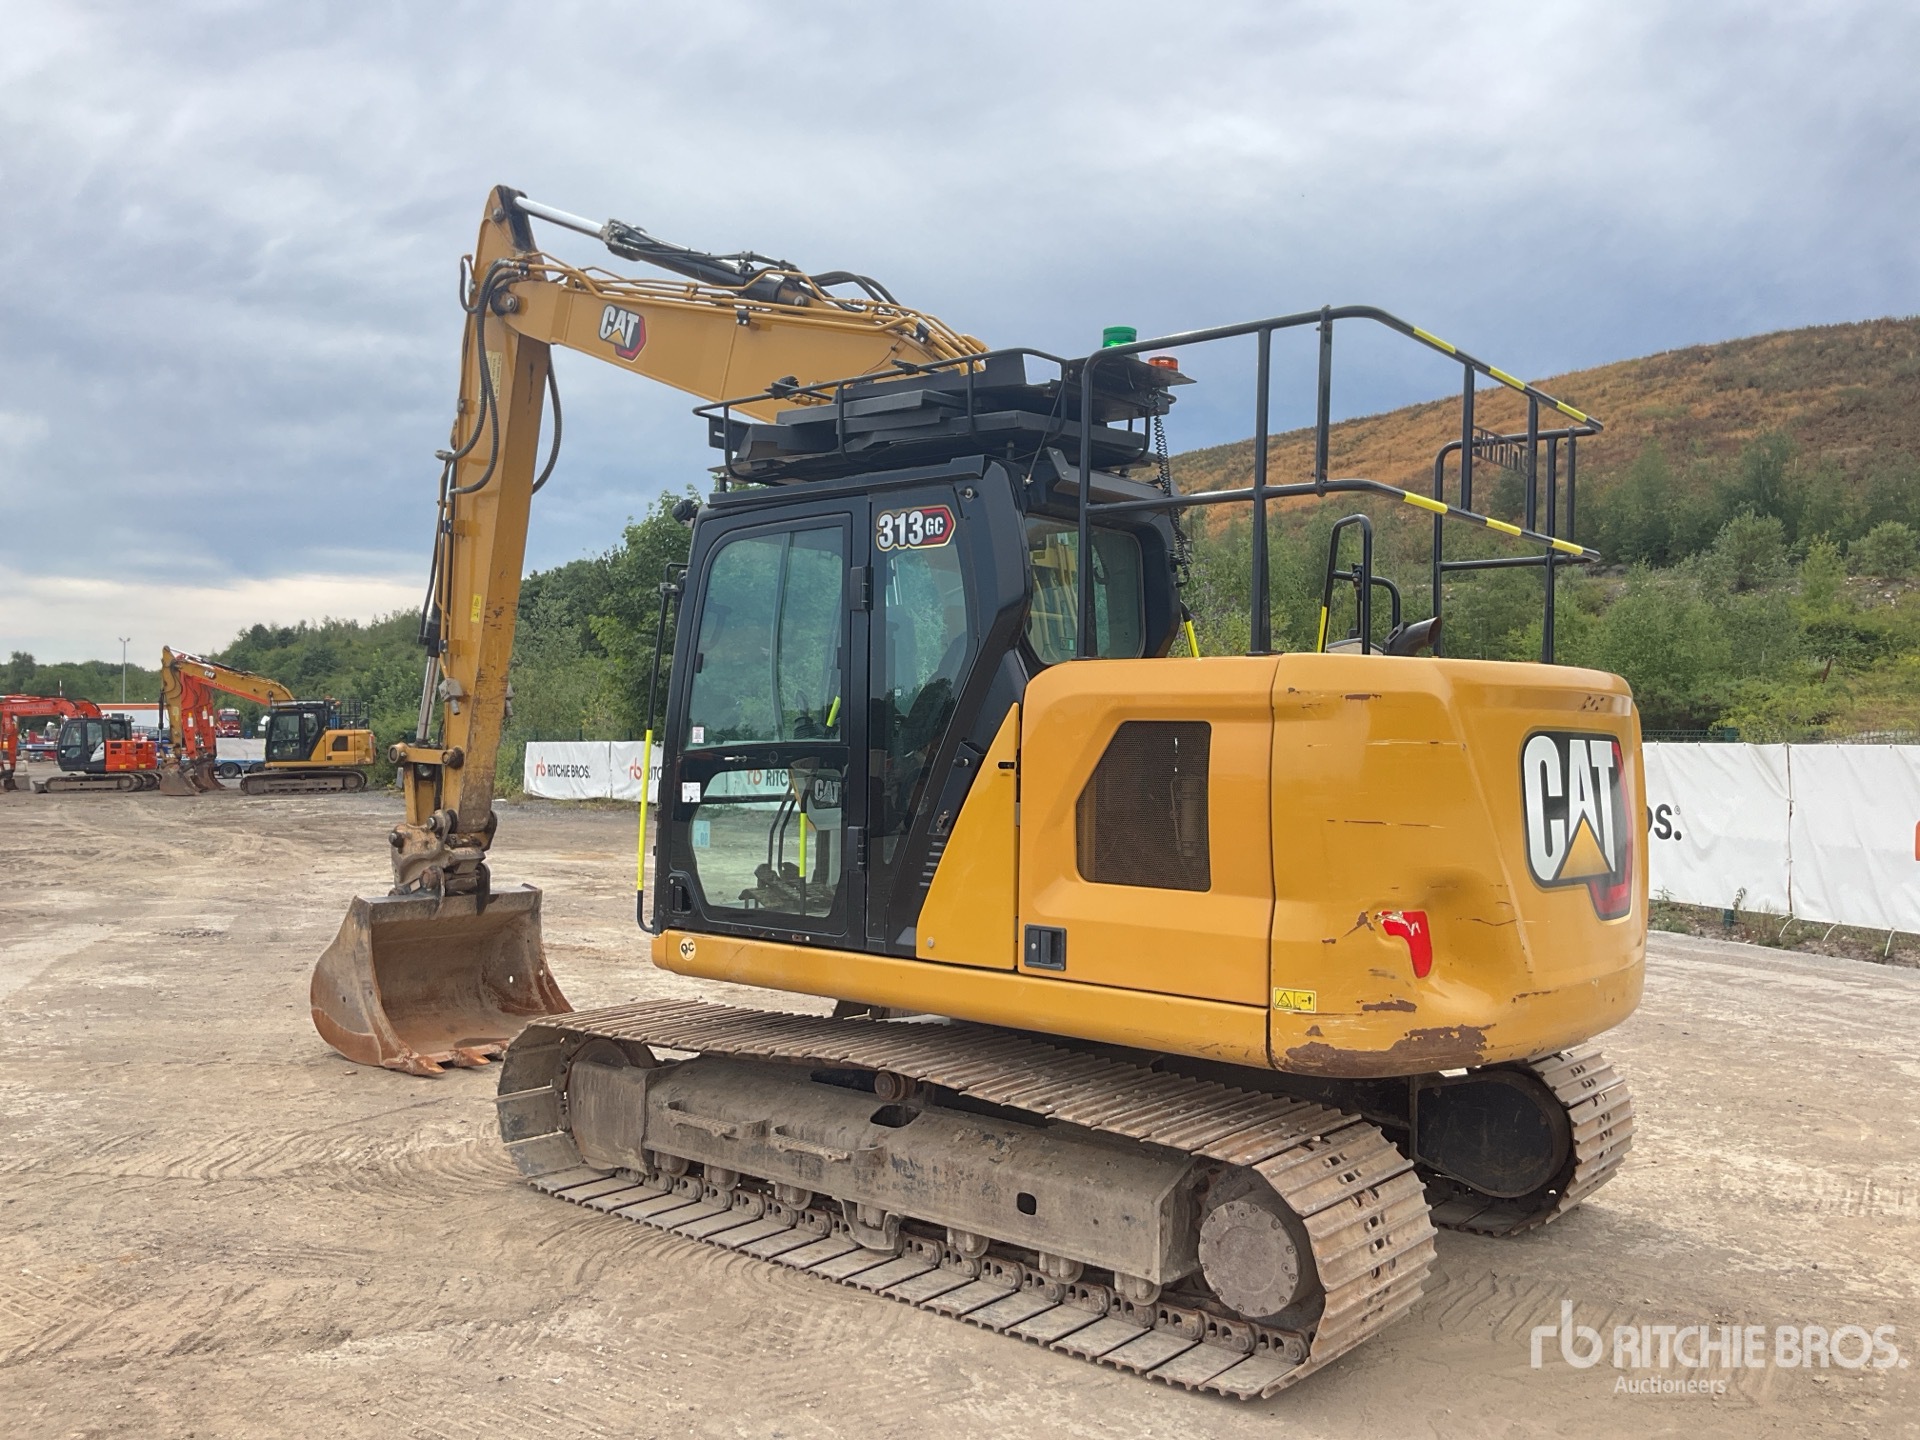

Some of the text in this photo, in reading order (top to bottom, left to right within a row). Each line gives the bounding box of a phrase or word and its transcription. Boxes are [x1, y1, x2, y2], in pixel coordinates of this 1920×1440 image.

[600, 305, 640, 348] CAT
[879, 510, 944, 548] 313 GC
[547, 764, 570, 778] RITCHIE
[814, 779, 841, 803] CAT
[1524, 735, 1616, 881] CAT
